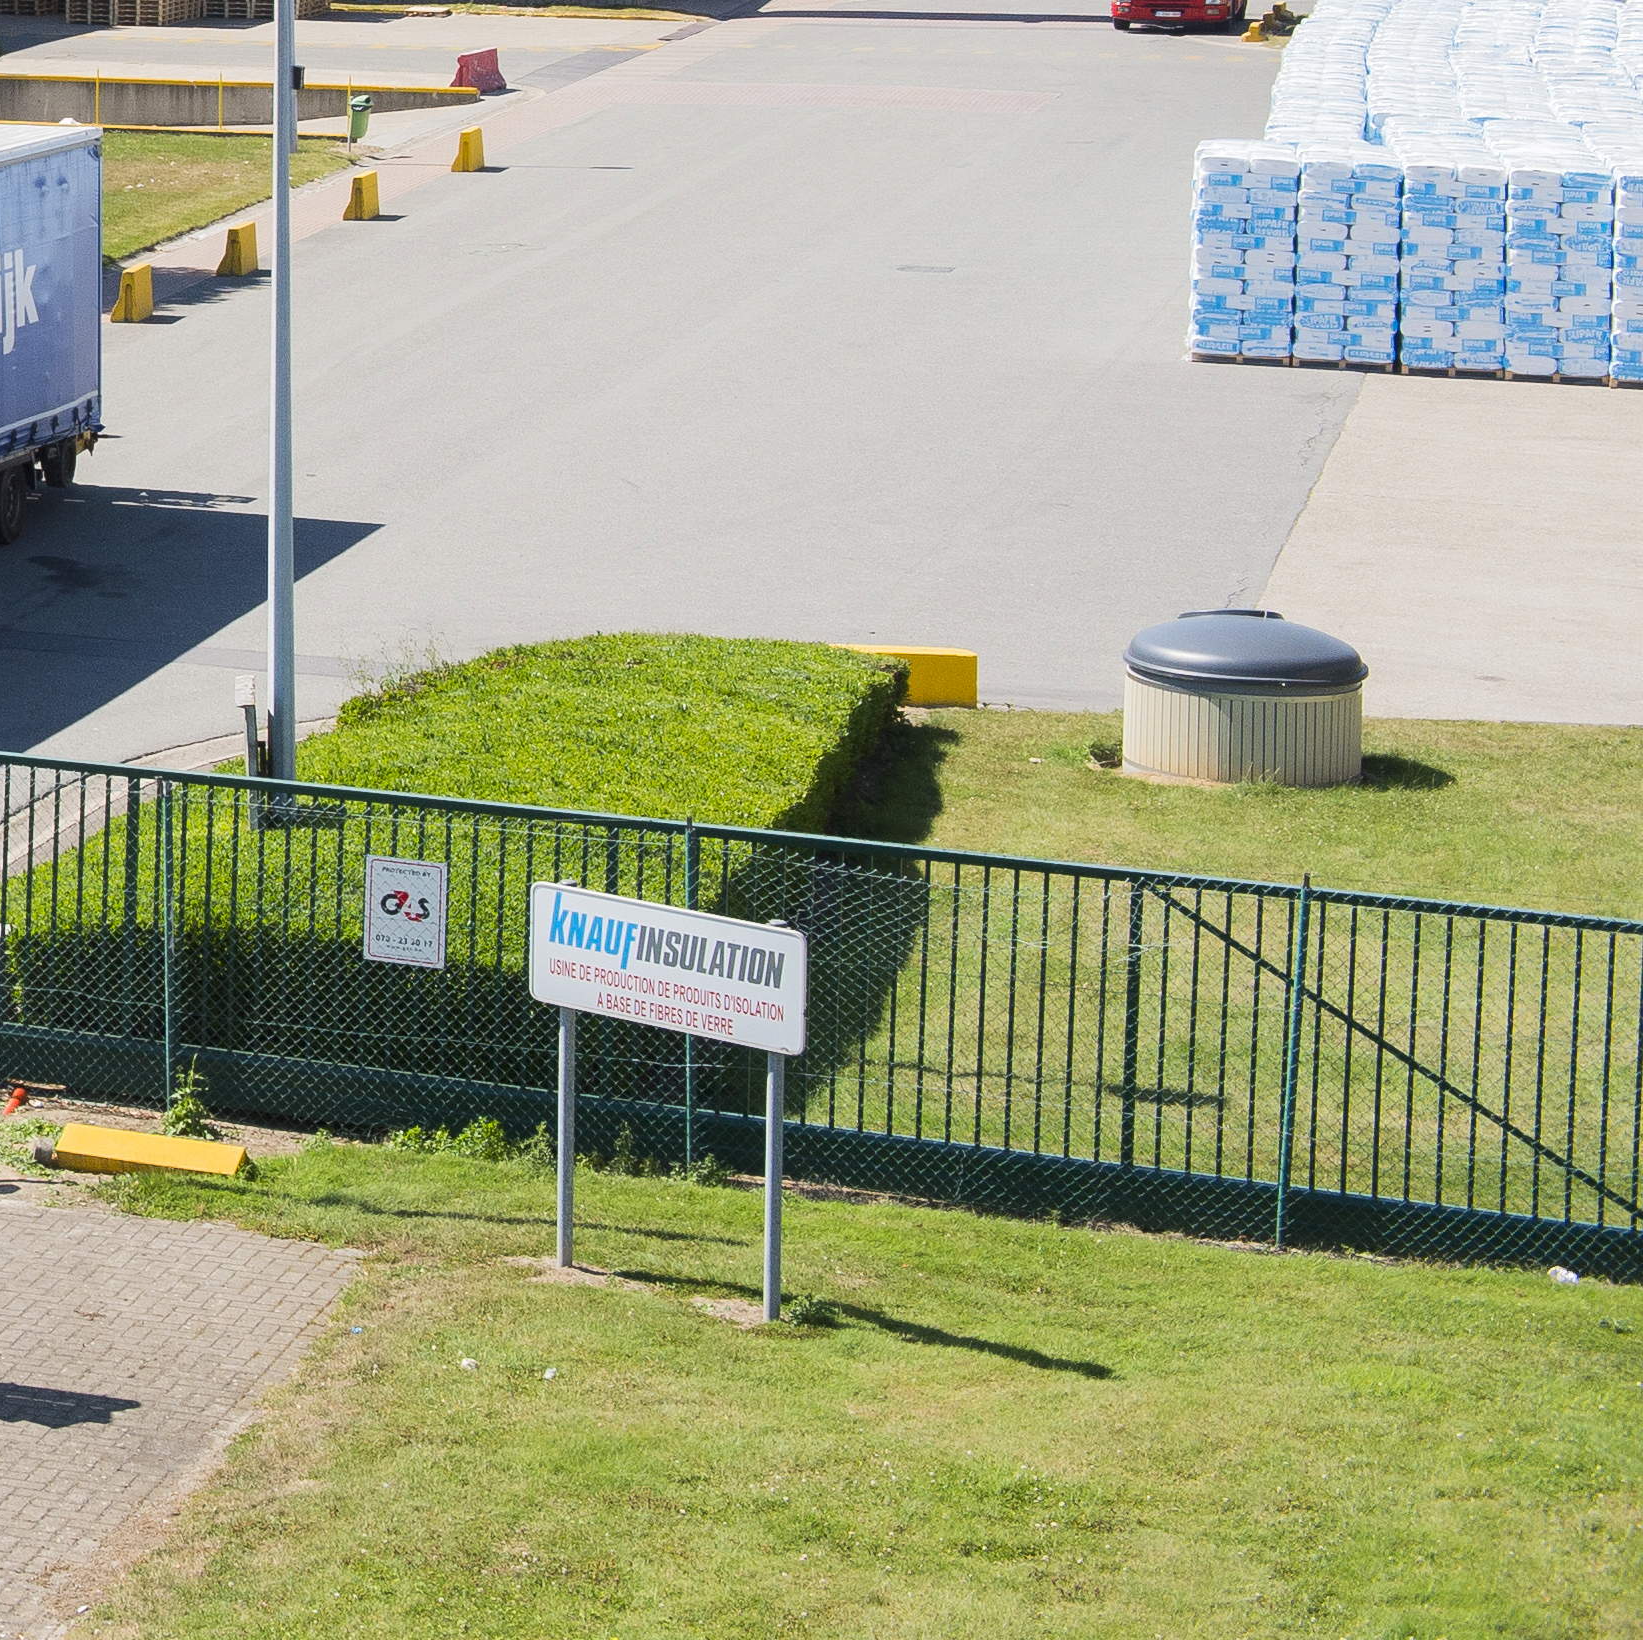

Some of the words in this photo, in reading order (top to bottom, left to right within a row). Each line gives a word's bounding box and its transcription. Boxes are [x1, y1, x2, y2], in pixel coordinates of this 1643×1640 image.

[382, 866, 421, 876] PROTECTED
[635, 925, 785, 990] INSULATION
[549, 958, 577, 980] USINE
[579, 964, 592, 982] DE
[594, 967, 655, 996] PRODUCTION
[658, 980, 671, 999] DE
[673, 984, 721, 1009] PRODUITS
[724, 994, 785, 1022] D'ISOLATION
[597, 992, 605, 1008] A
[607, 992, 631, 1014] BASE
[633, 998, 647, 1018] DE
[649, 1002, 683, 1024] FIBRES
[685, 1010, 699, 1028] DE
[701, 1014, 733, 1036] VERRE
